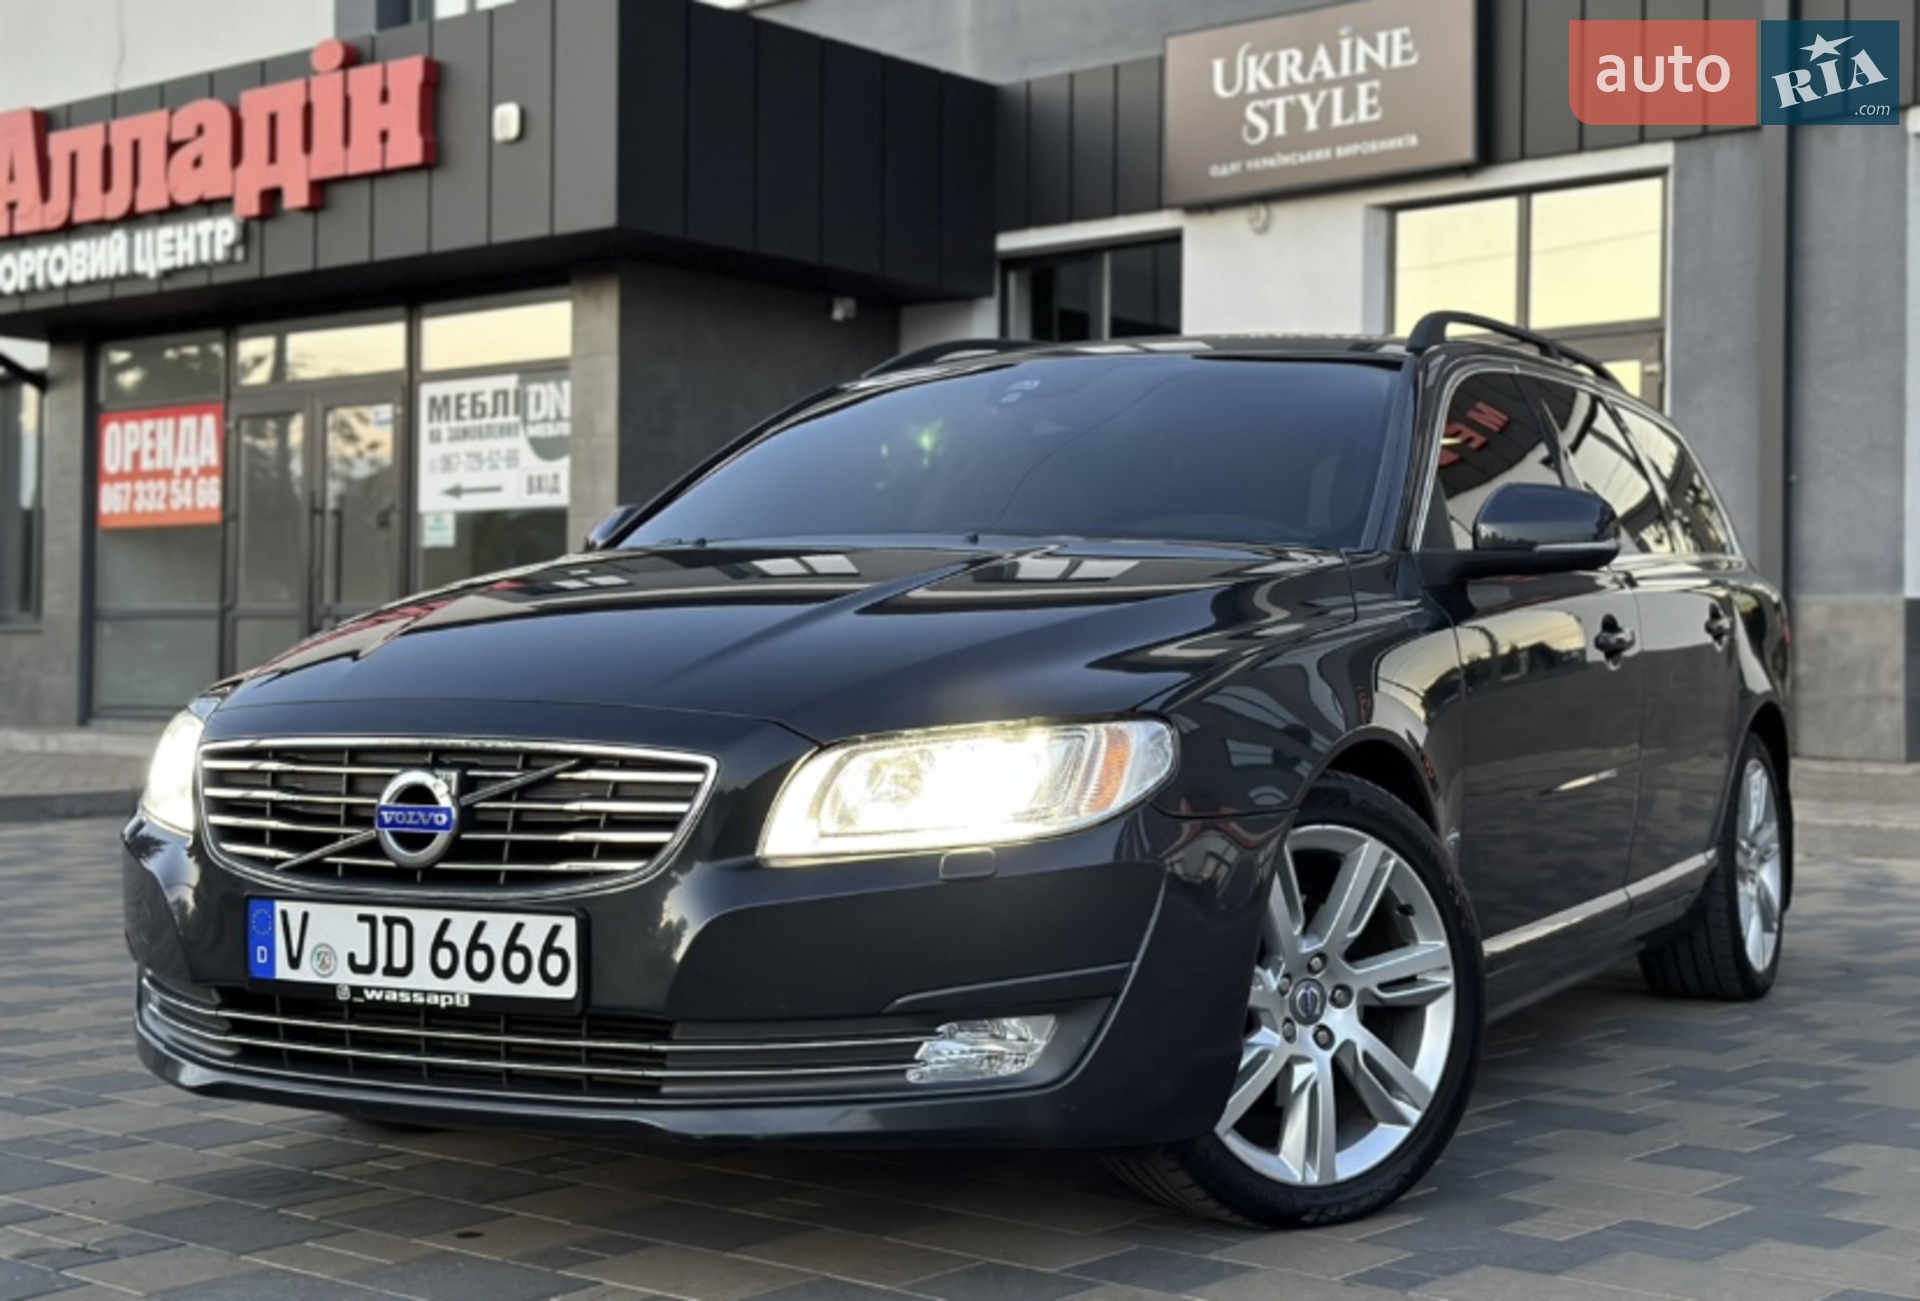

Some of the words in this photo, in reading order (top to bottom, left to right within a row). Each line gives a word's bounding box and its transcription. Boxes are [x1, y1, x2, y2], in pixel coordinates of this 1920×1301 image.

[0, 38, 434, 236] Алладін
[1242, 80, 1383, 146] STYLE
[0, 229, 129, 294] ОРГОВИЙ
[428, 388, 520, 424] МЕБЛІ
[526, 380, 570, 421] DN
[104, 414, 218, 477] ОРЕНДА
[133, 479, 168, 513] 332
[170, 478, 193, 510] 54
[380, 811, 448, 826] VOLVO
[256, 946, 268, 964] D
[280, 908, 310, 971] V
[348, 913, 414, 979] JD
[430, 918, 571, 987] 6666
